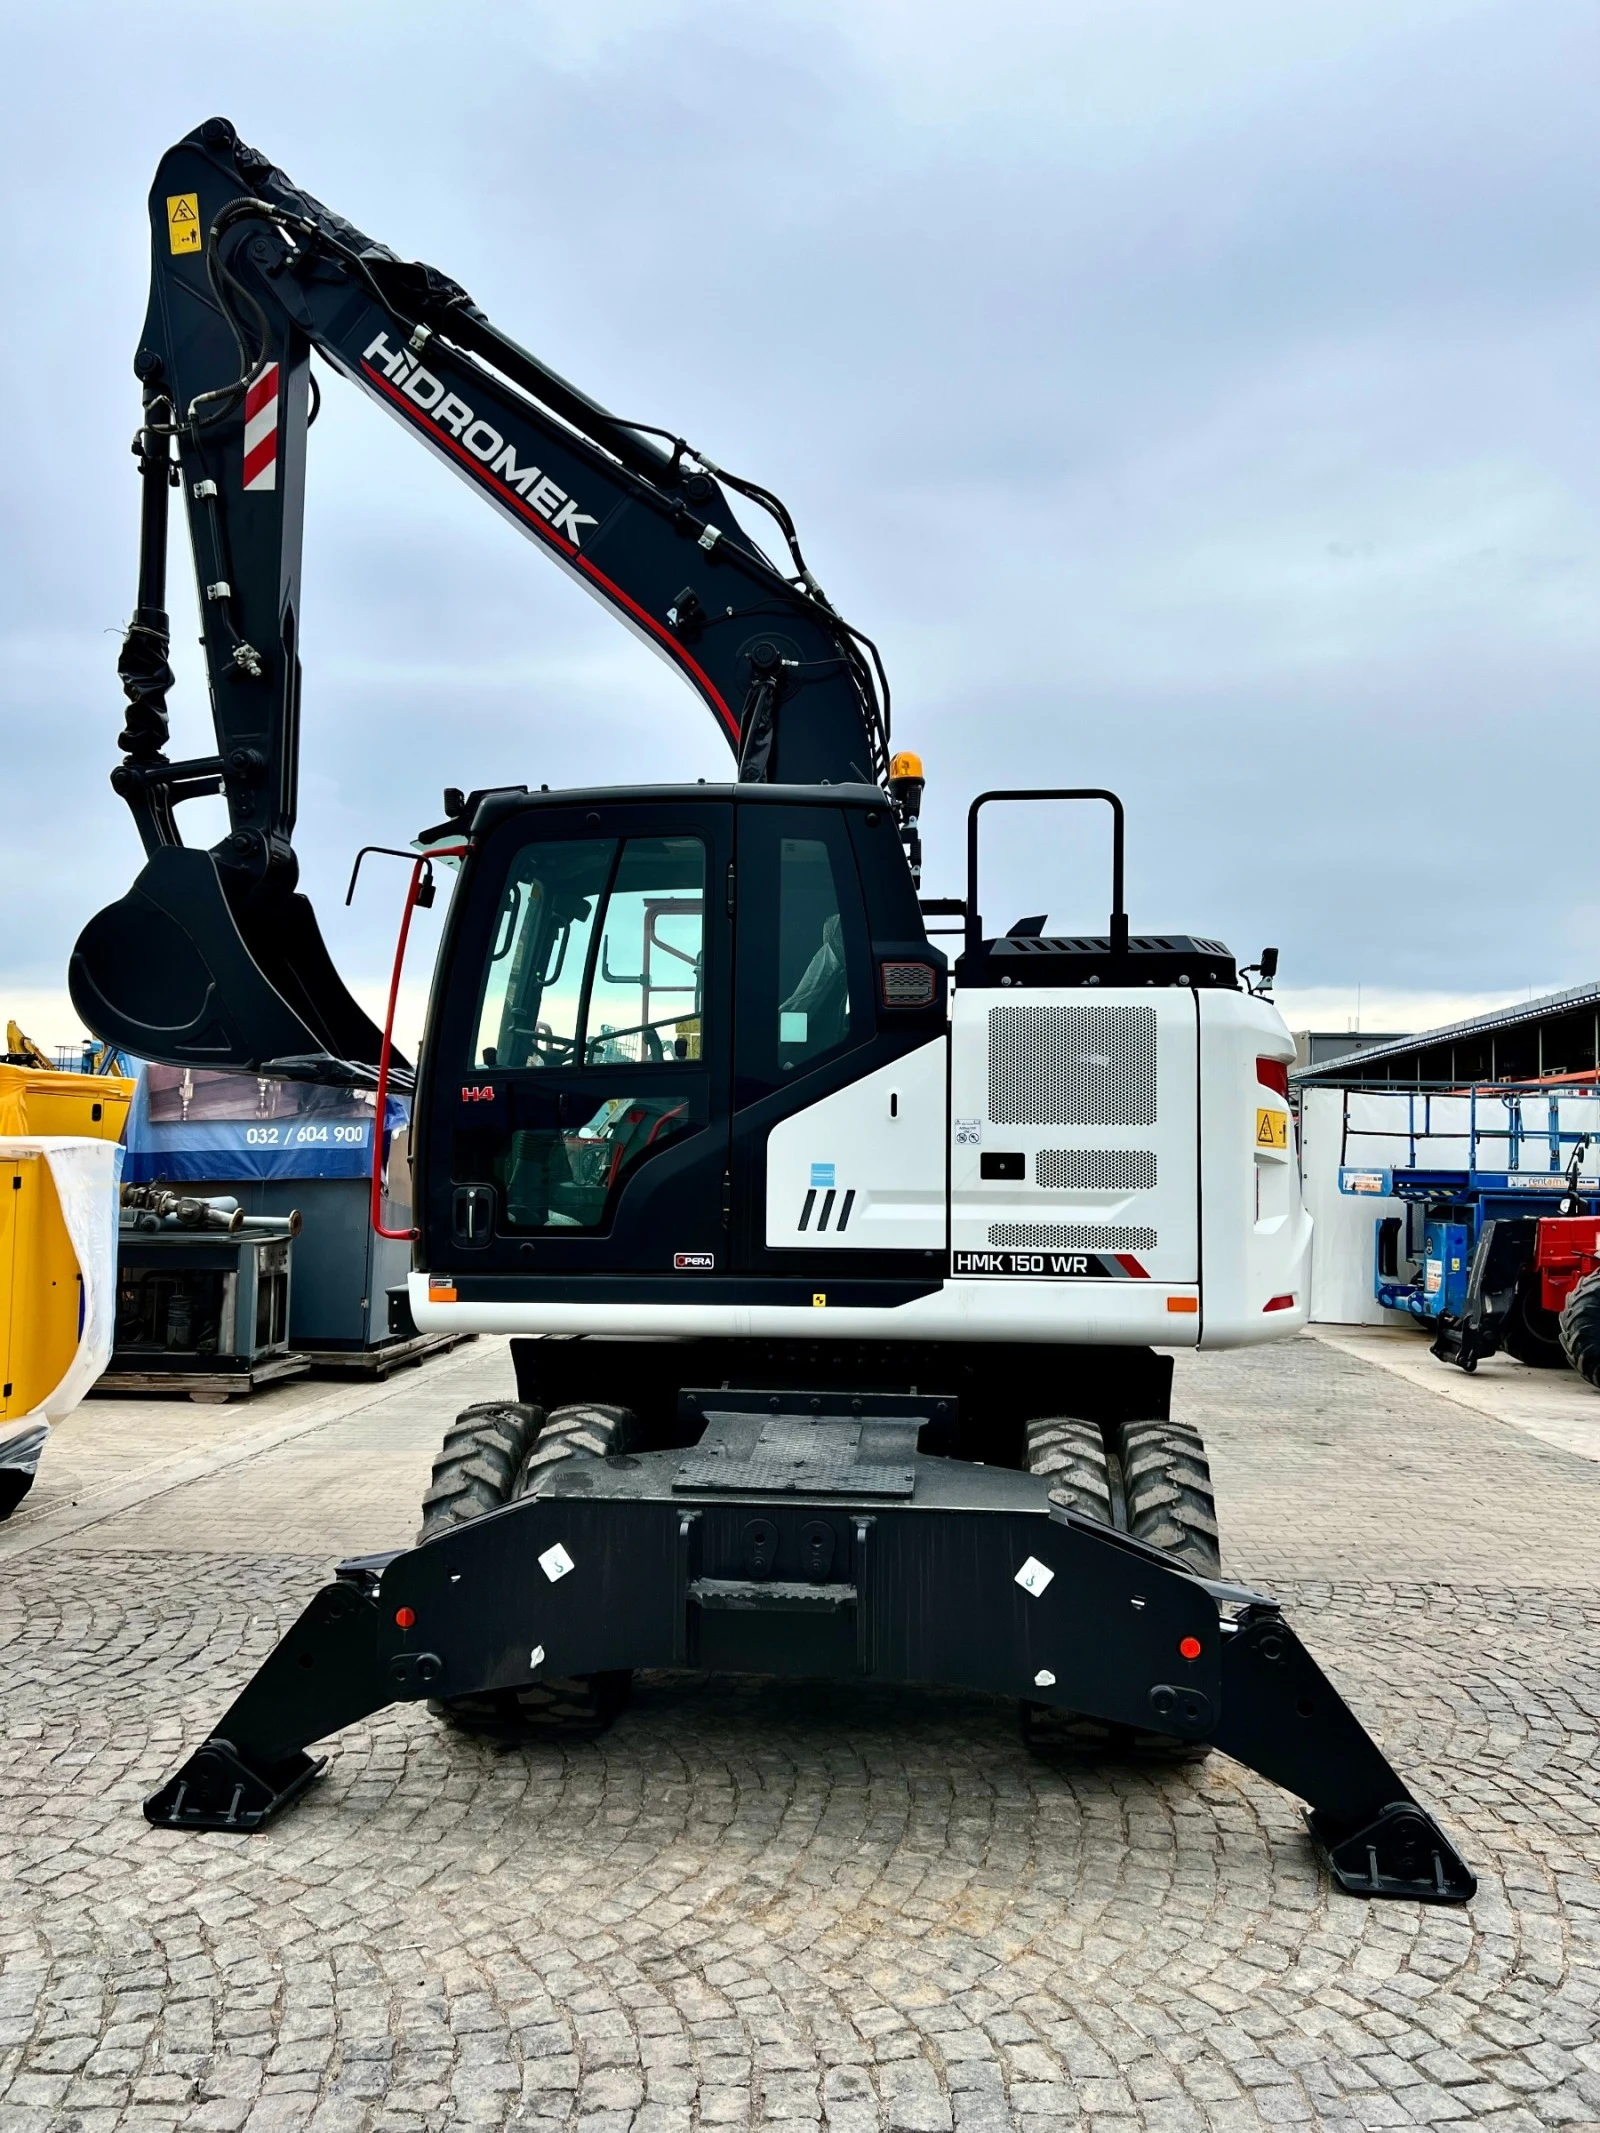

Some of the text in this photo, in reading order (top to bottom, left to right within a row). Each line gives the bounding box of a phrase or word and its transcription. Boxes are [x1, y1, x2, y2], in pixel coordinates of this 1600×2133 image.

[461, 1086, 495, 1101] H4
[246, 1126, 363, 1146] 032 / 604 900
[957, 1253, 1088, 1273] HMK 150 WR
